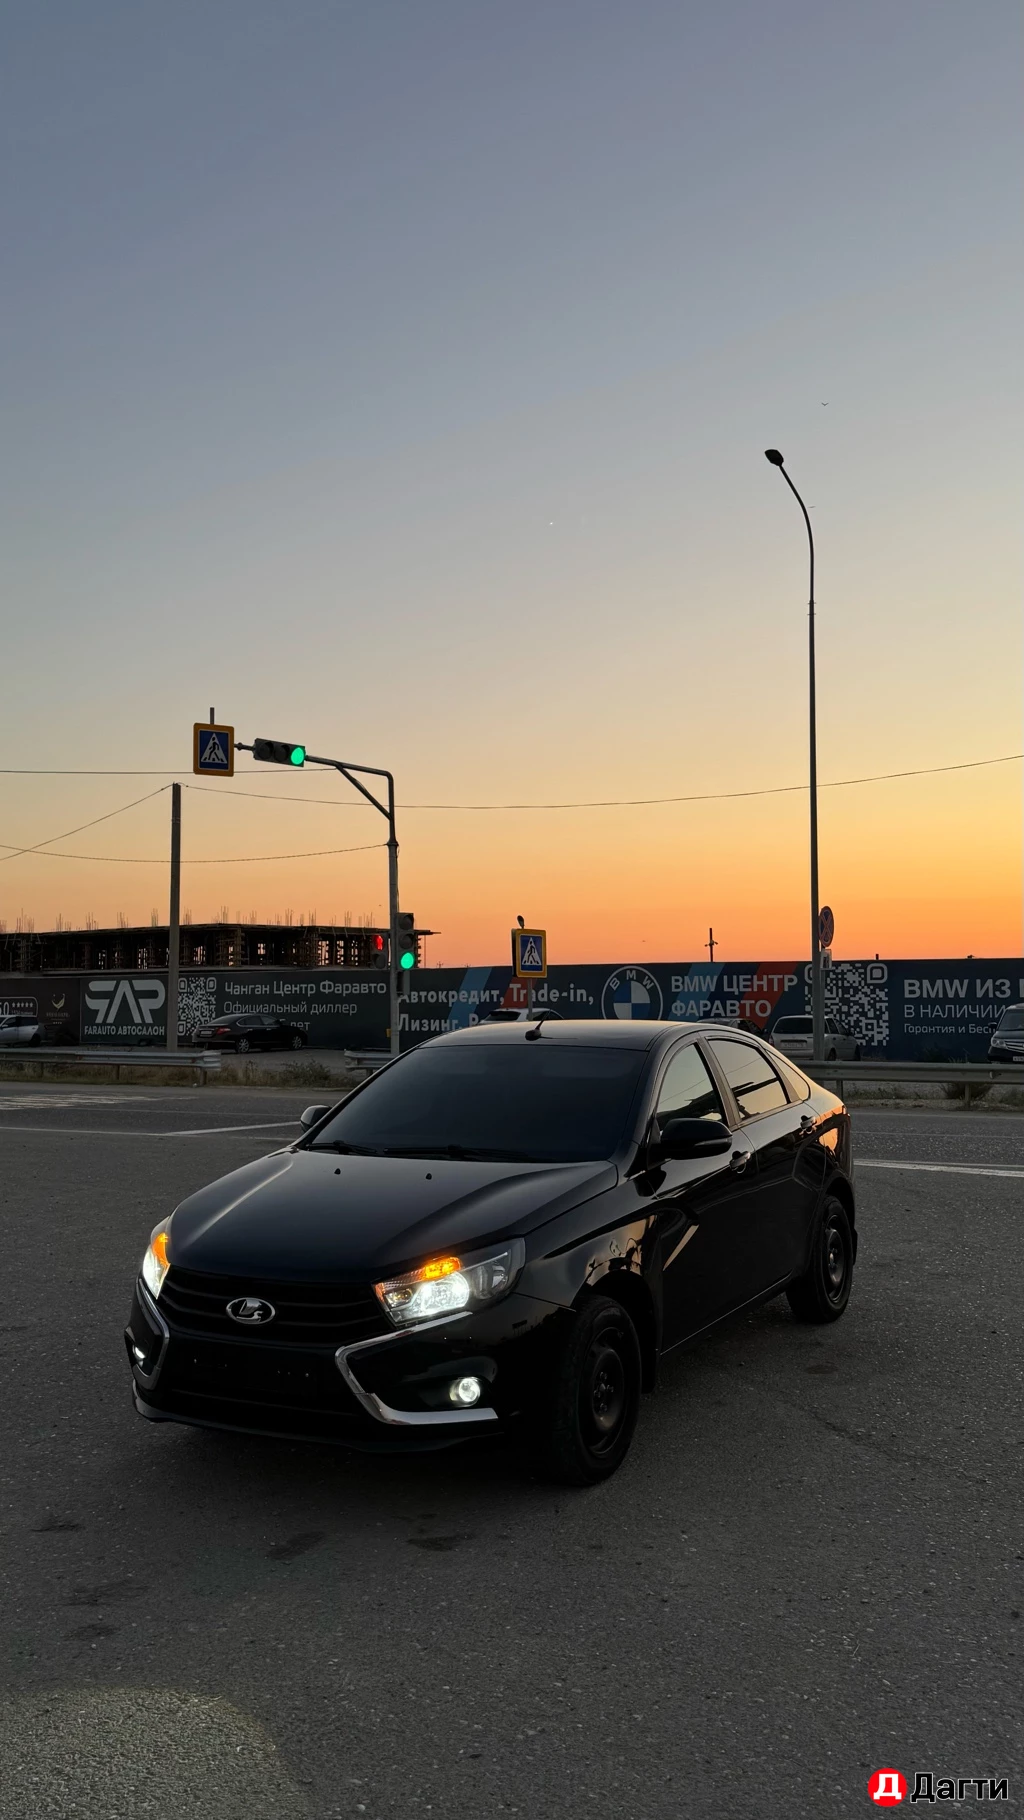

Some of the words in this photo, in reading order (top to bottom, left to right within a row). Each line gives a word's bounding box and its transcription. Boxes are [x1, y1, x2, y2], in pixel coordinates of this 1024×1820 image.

[224, 981, 270, 995] Чанган
[273, 980, 316, 997] Центр
[319, 979, 387, 996] Фаравто
[609, 969, 655, 991] BMW
[671, 974, 717, 992] BMW
[723, 974, 798, 995] ЦЕНТР
[903, 978, 968, 998] BMW
[976, 978, 1011, 998] ИЗ
[223, 1000, 307, 1015] Официальный
[310, 1002, 358, 1016] диллер
[671, 999, 772, 1018] ФАРАВТО
[903, 1004, 916, 1018] В
[84, 1025, 116, 1036] FARAUTO
[117, 1025, 165, 1036] АВТОСАЛОН
[904, 1023, 955, 1035] Гарантия
[958, 1025, 966, 1034] и
